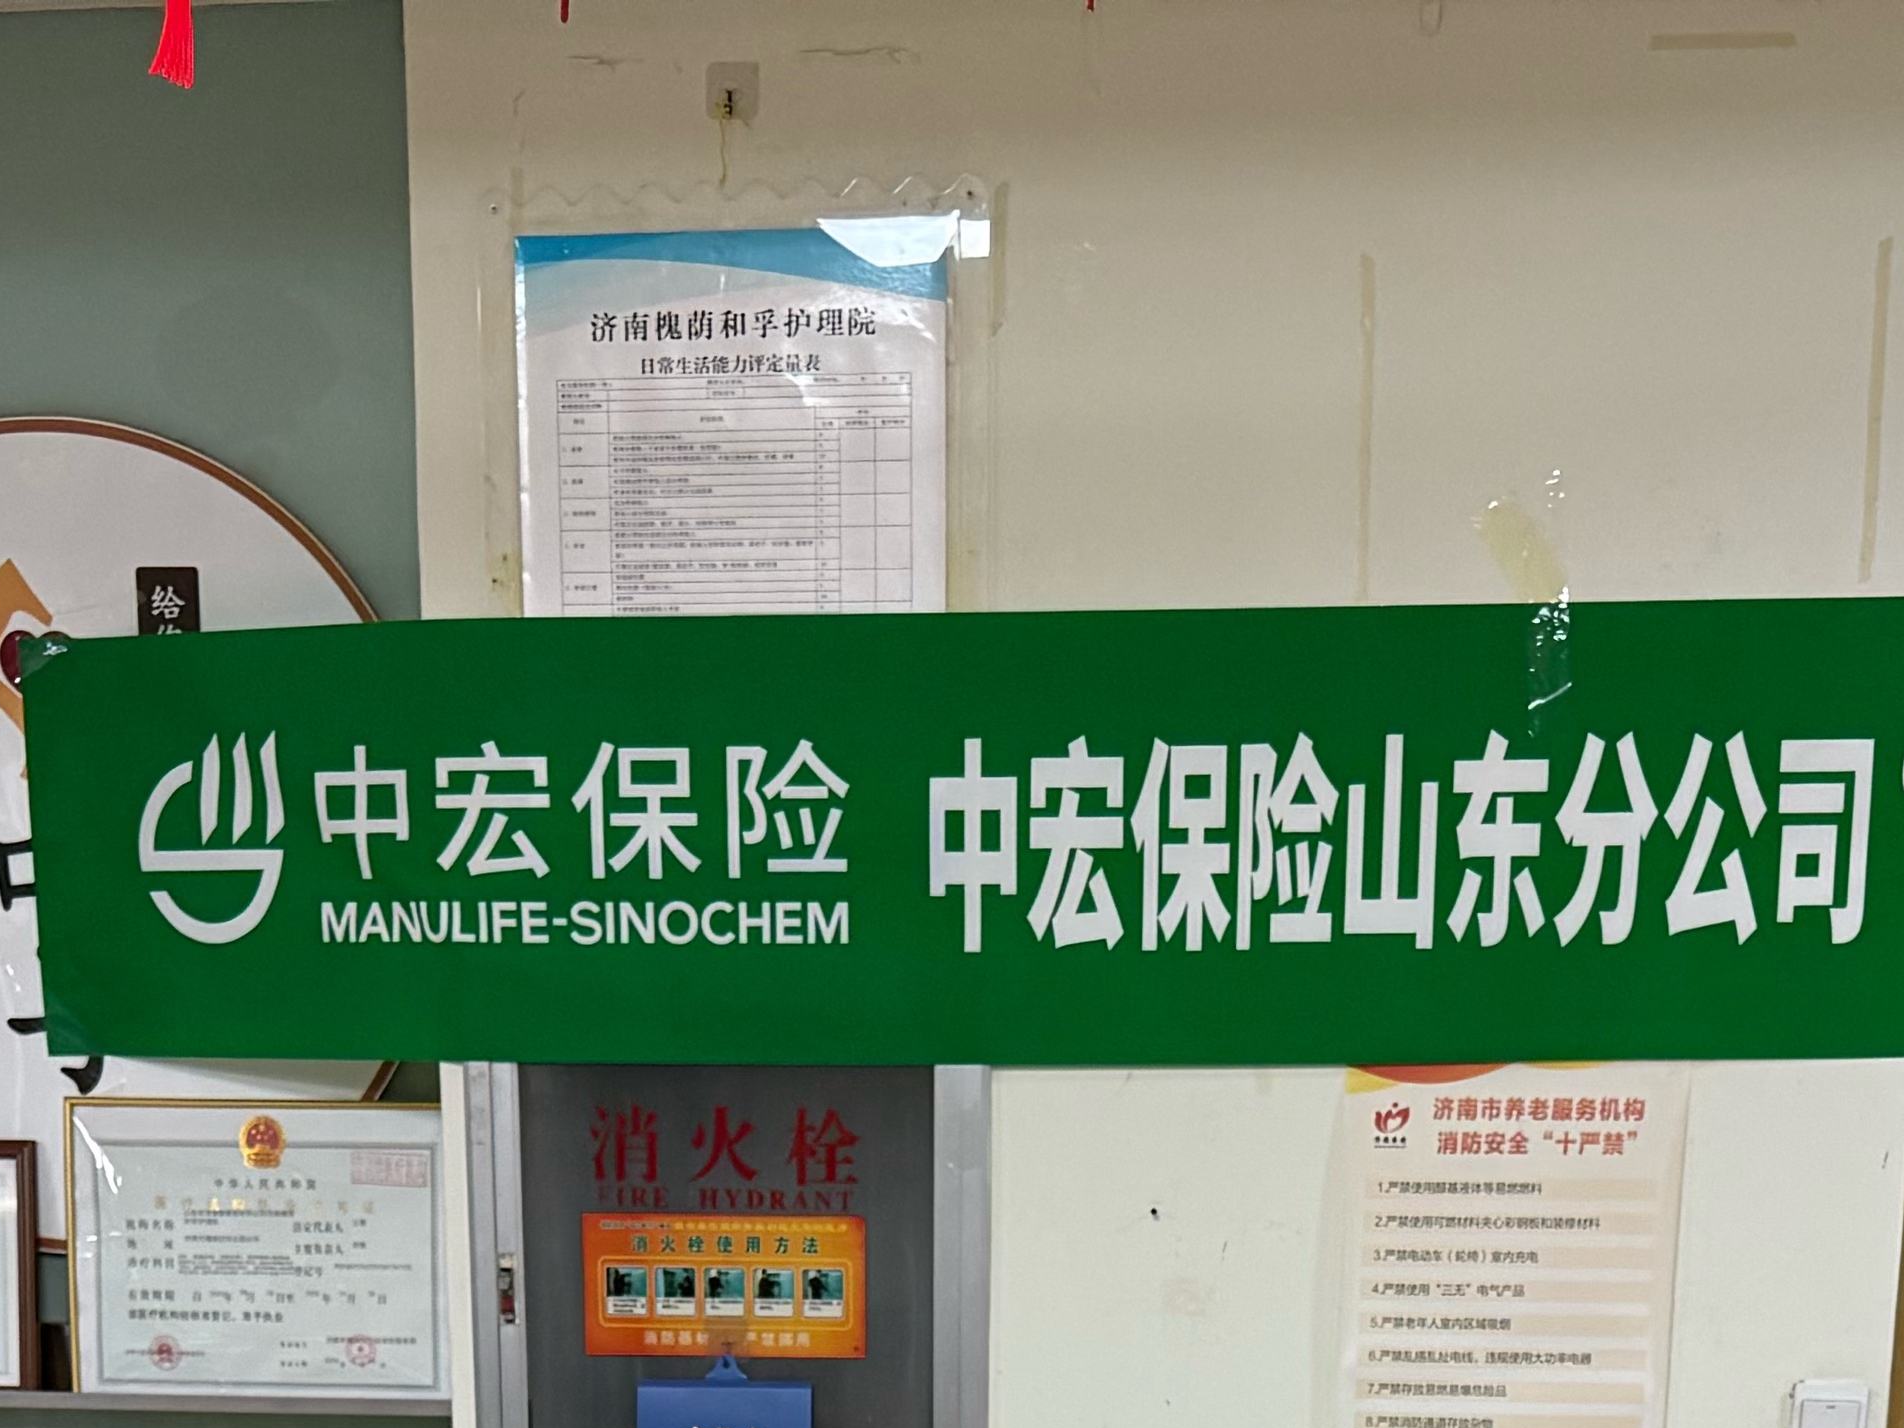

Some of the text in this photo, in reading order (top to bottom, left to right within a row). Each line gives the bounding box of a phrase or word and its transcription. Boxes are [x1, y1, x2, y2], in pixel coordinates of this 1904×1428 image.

[590, 307, 877, 343] 济南槐荫和孚护理院
[640, 353, 822, 376] 日常生活能力评定量表
[313, 738, 851, 882] 中宏保险
[320, 900, 850, 946] MANULIFE-SINOCHEM
[1432, 1096, 1647, 1122] 济南市养老服务机构
[589, 1104, 861, 1187] 消火栓
[1437, 1130, 1639, 1156] 消防安全“十严禁”
[598, 1187, 856, 1211] FIRE HYDRANT
[630, 1234, 820, 1255] 消火栓使用方法
